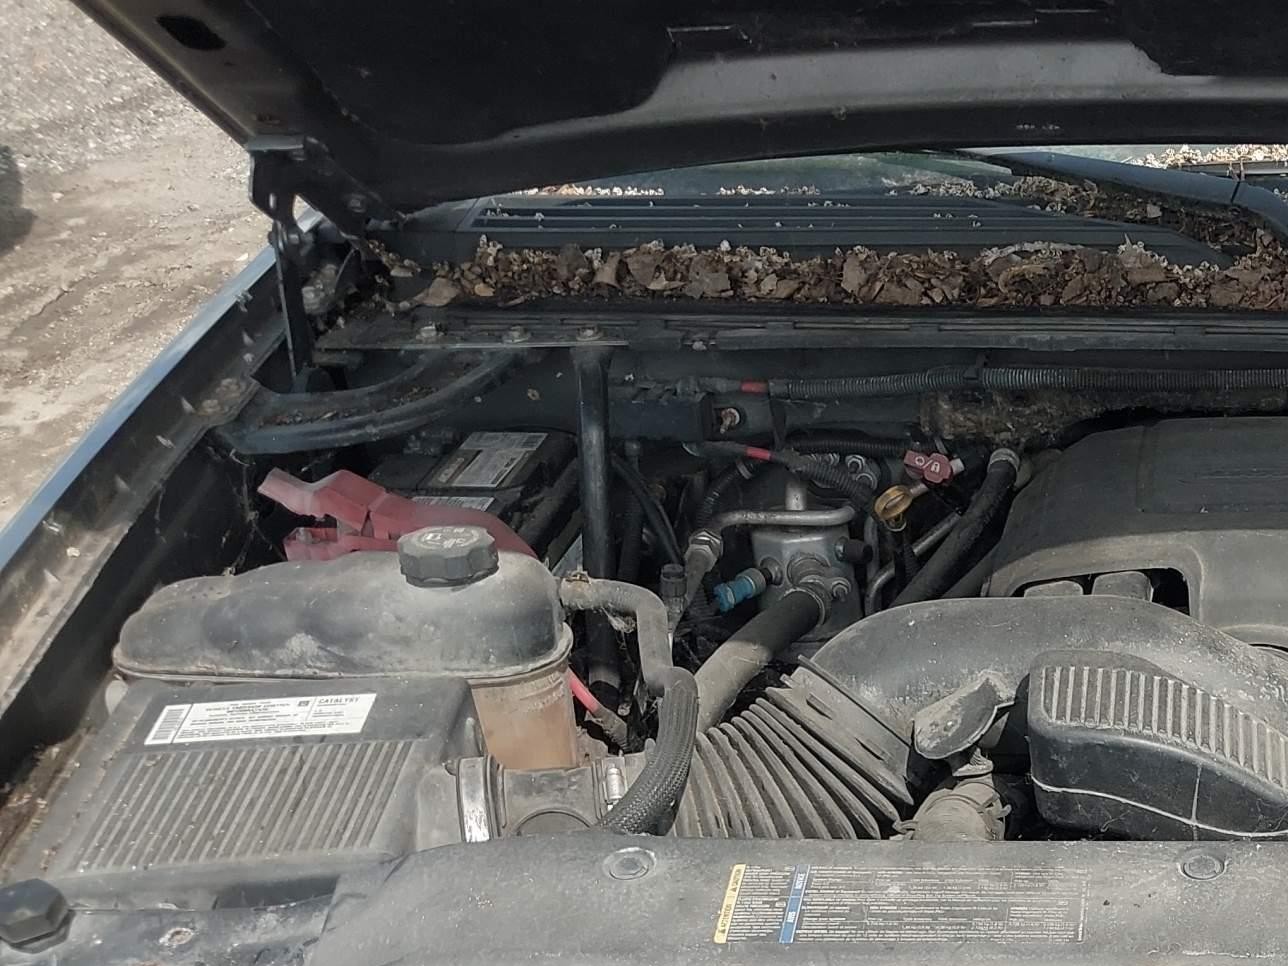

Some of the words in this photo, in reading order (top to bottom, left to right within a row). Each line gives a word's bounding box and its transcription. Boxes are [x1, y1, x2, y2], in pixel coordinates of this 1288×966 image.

[731, 868, 742, 887] CAUTION
[794, 872, 806, 890] NOTICE
[720, 903, 732, 928] ATTENTION
